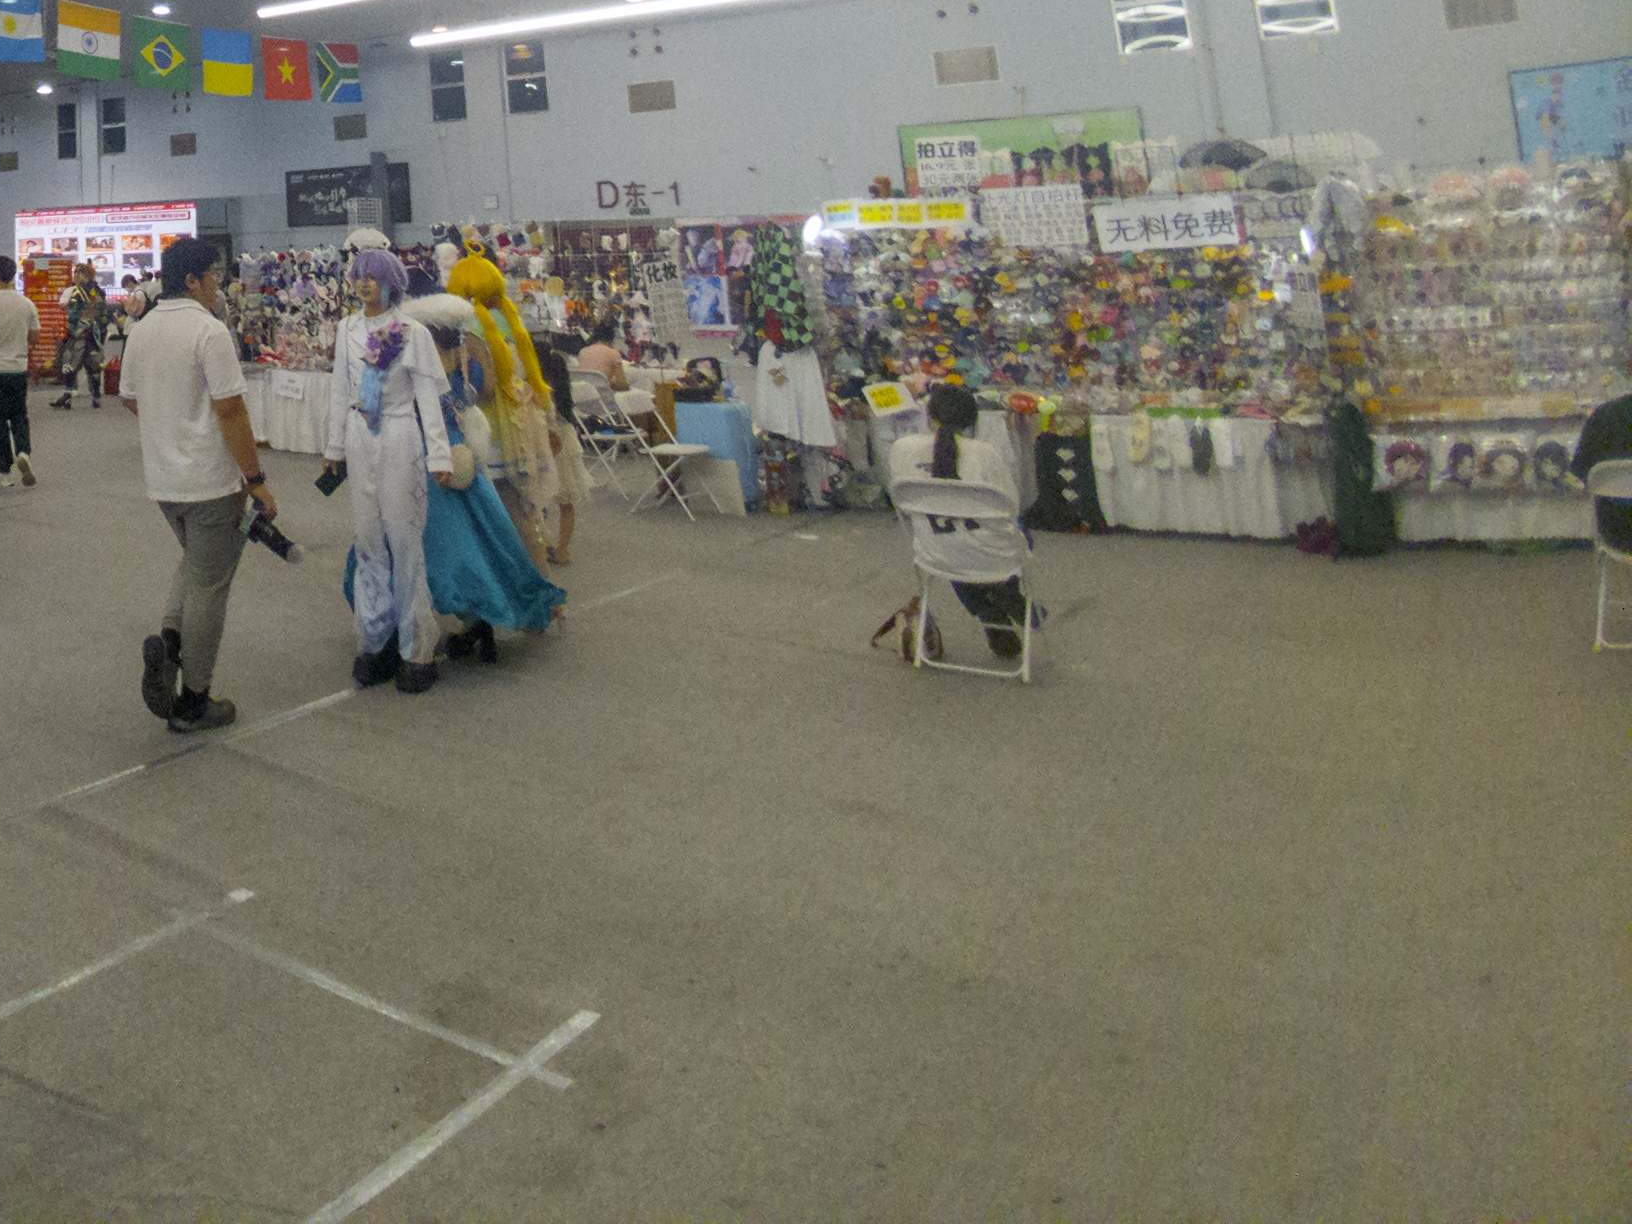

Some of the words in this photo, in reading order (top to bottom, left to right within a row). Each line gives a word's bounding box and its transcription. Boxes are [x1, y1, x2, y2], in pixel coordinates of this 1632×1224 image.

[917, 141, 975, 158] 拍立得
[596, 181, 680, 208] D东-1
[1107, 208, 1235, 243] 无料免费
[647, 261, 678, 284] 化妆
